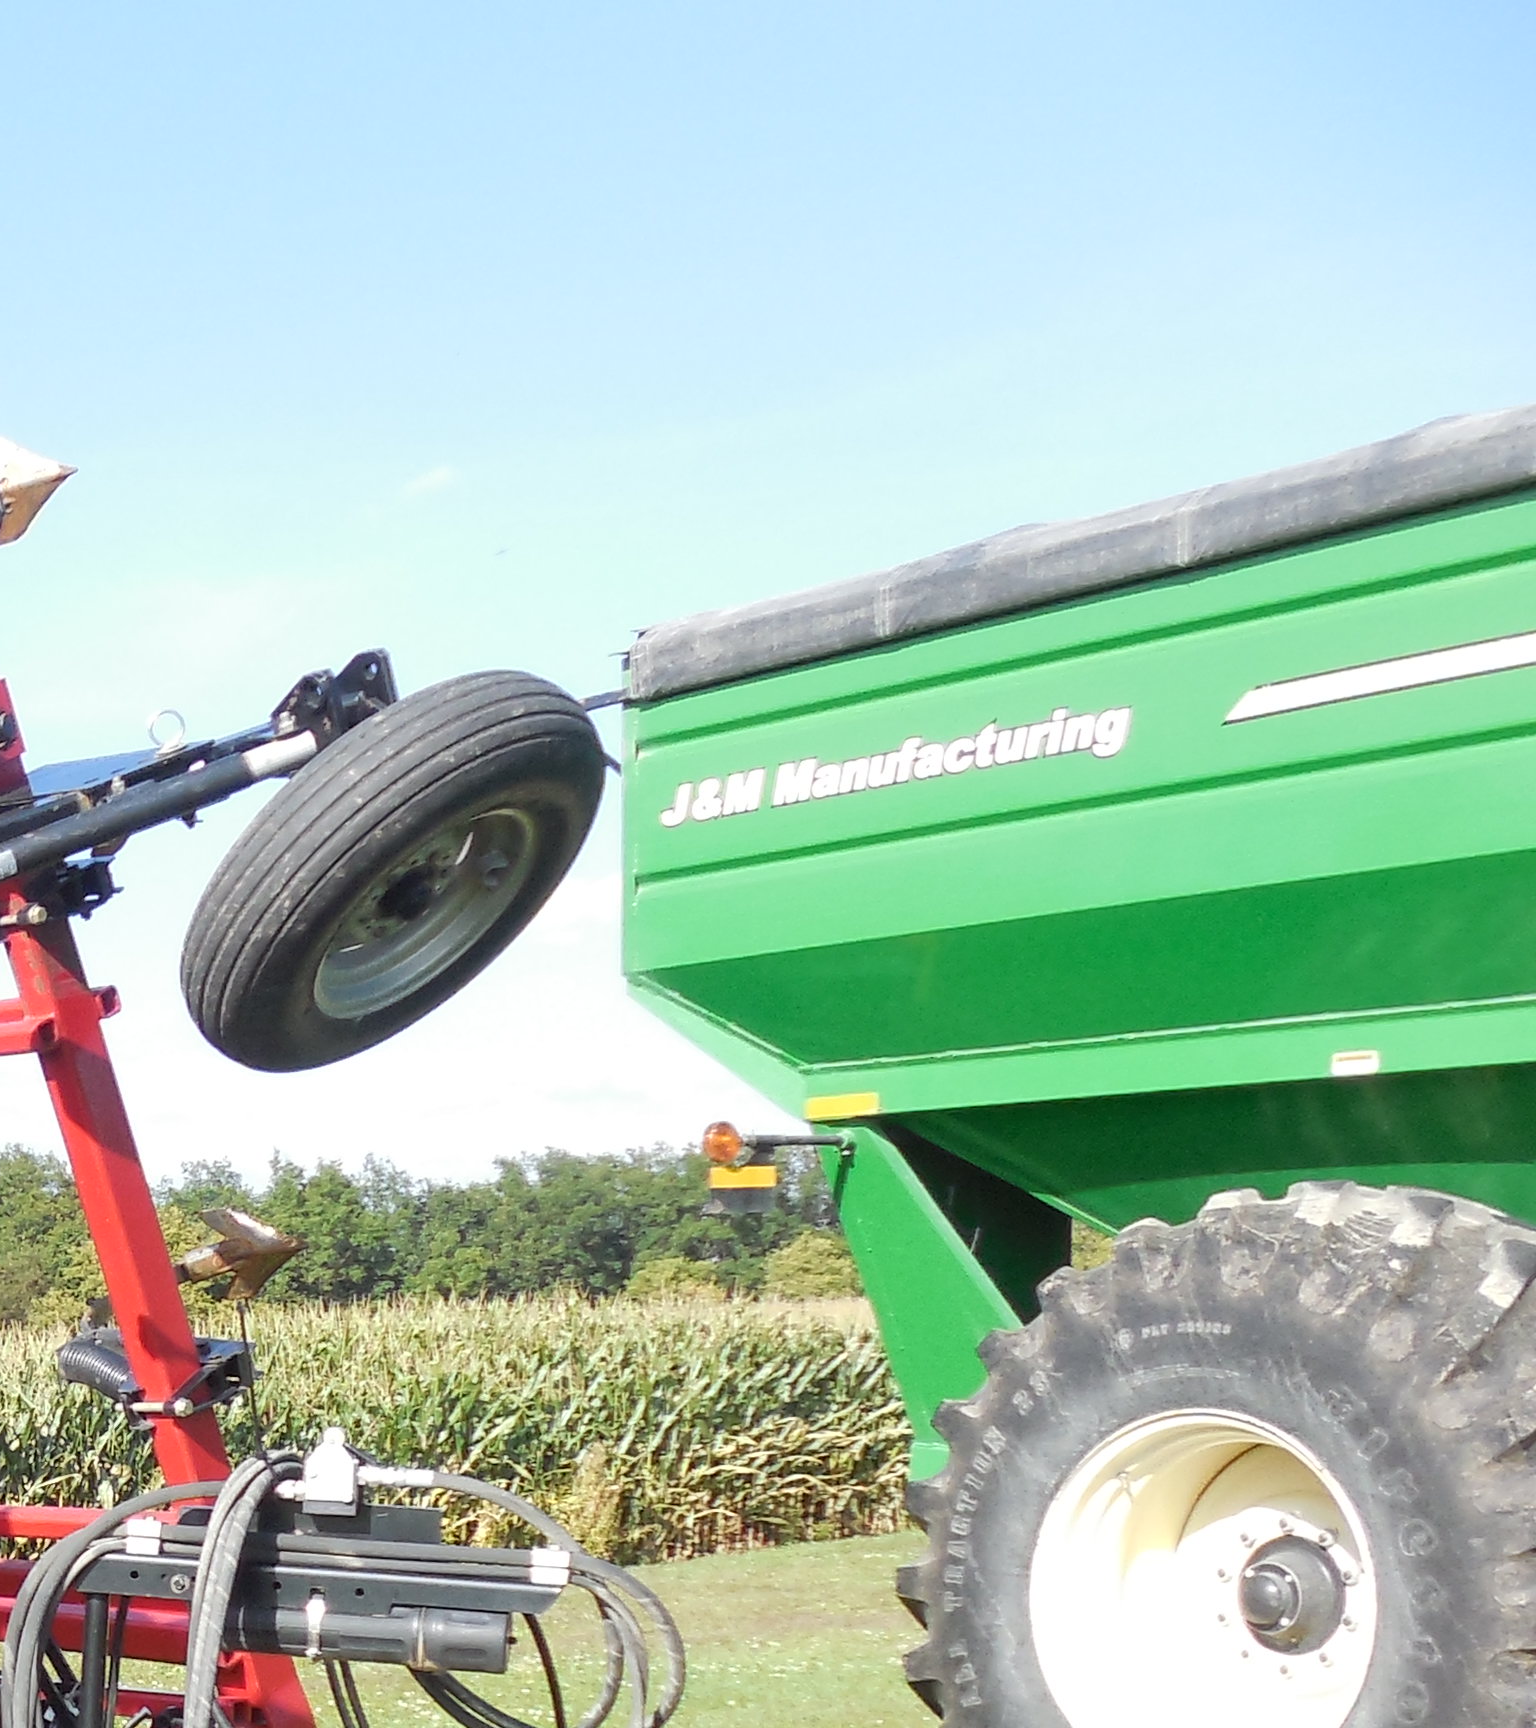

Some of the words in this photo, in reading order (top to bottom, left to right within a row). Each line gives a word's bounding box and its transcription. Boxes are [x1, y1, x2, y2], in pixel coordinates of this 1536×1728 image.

[659, 766, 766, 828] J&M
[770, 705, 1132, 809] Manufacturing
[942, 1425, 1007, 1613] TRACTION
